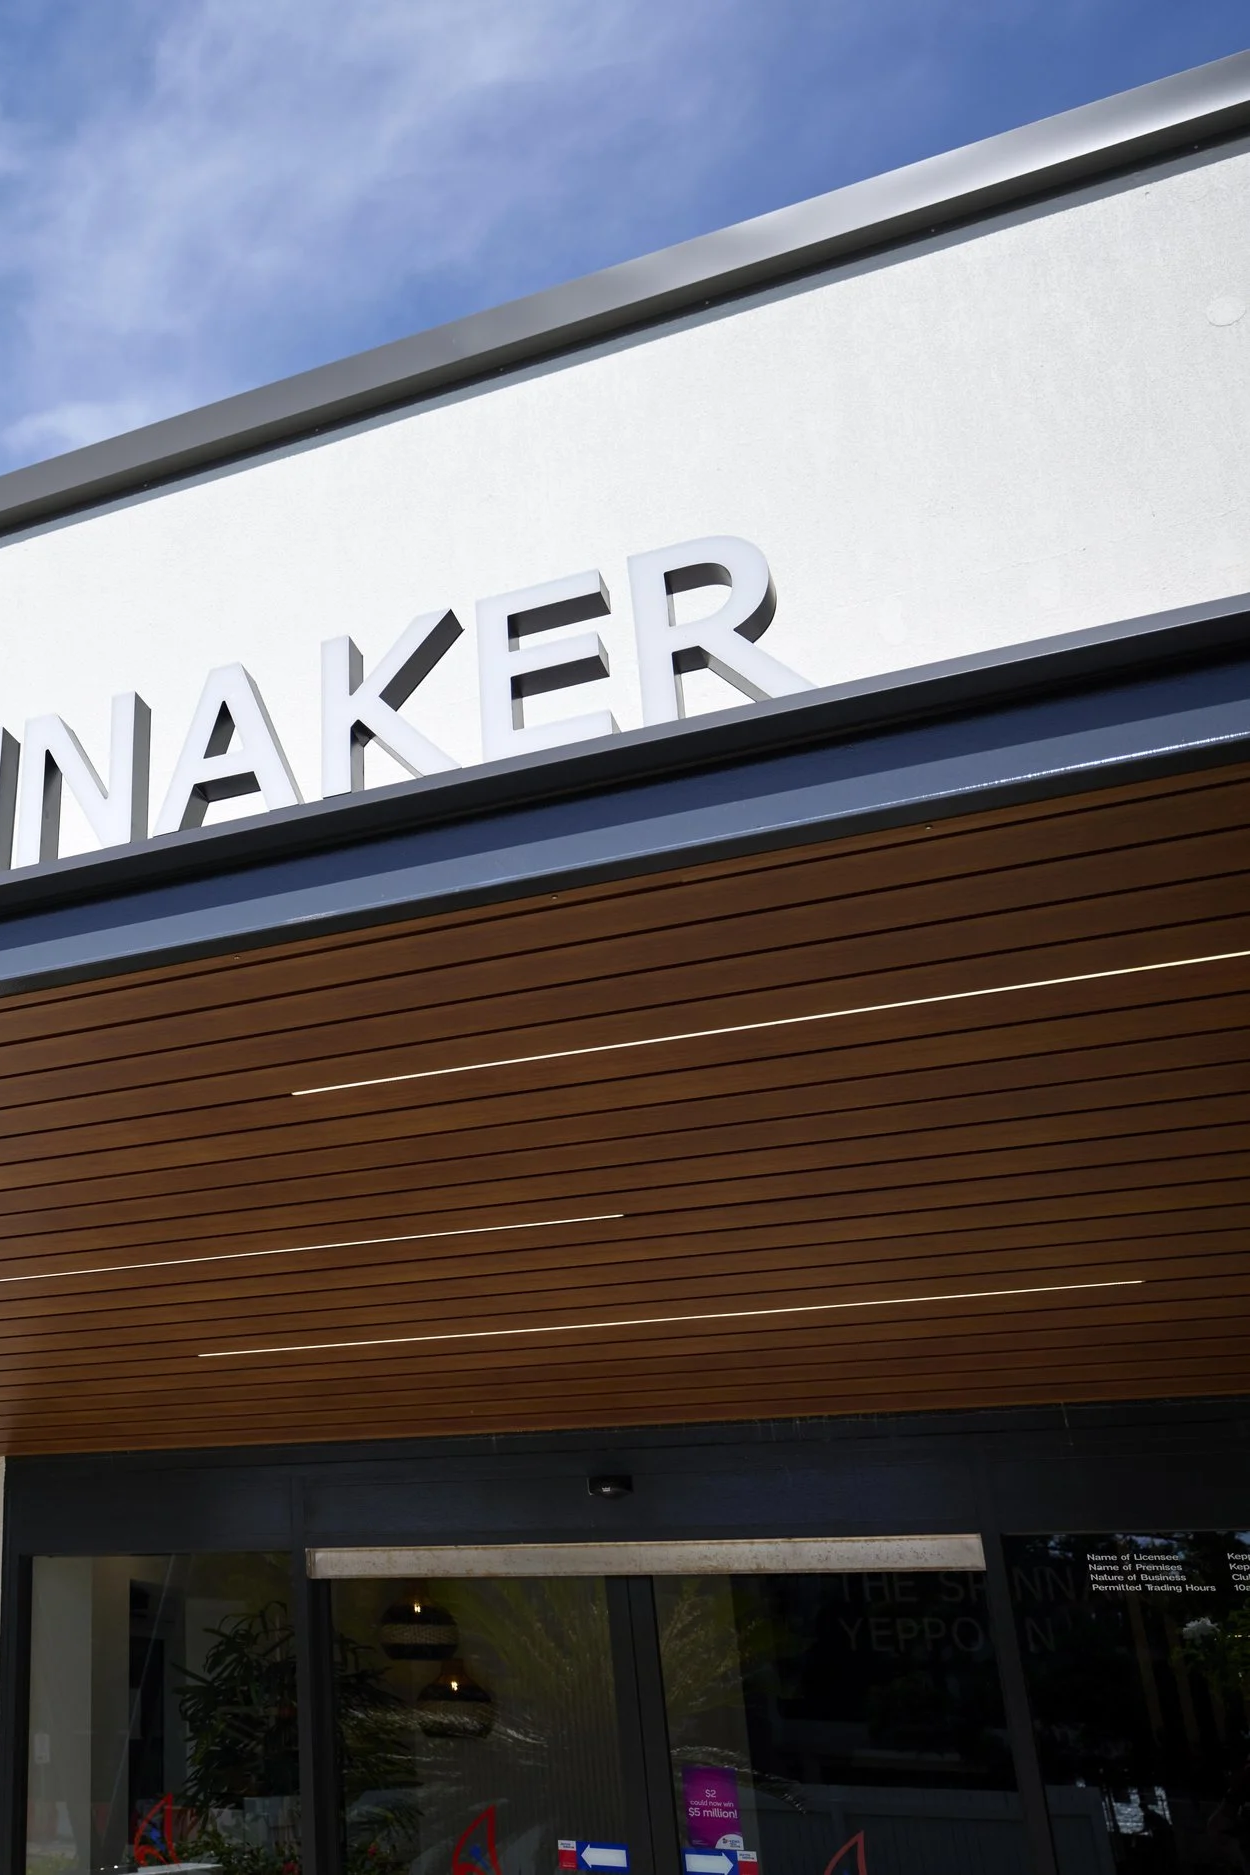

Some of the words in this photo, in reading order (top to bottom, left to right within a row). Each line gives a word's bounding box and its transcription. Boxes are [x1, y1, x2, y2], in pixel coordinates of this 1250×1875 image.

[1087, 1553, 1117, 1561] Name
[1121, 1553, 1130, 1561] of
[1134, 1553, 1179, 1561] Licensee
[1089, 1563, 1119, 1571] Name
[1123, 1563, 1132, 1571] of
[1136, 1563, 1183, 1571] Premises
[1090, 1573, 1124, 1581] Nature
[1128, 1573, 1137, 1581] of
[1141, 1573, 1187, 1581] Business
[1092, 1583, 1142, 1592] Permitted
[1145, 1583, 1183, 1593] Trading
[1186, 1584, 1217, 1592] Hours
[839, 1615, 1057, 1653] YEPPON
[705, 1789, 717, 1798] $2
[688, 1807, 701, 1817] $5
[703, 1808, 738, 1819] million!
